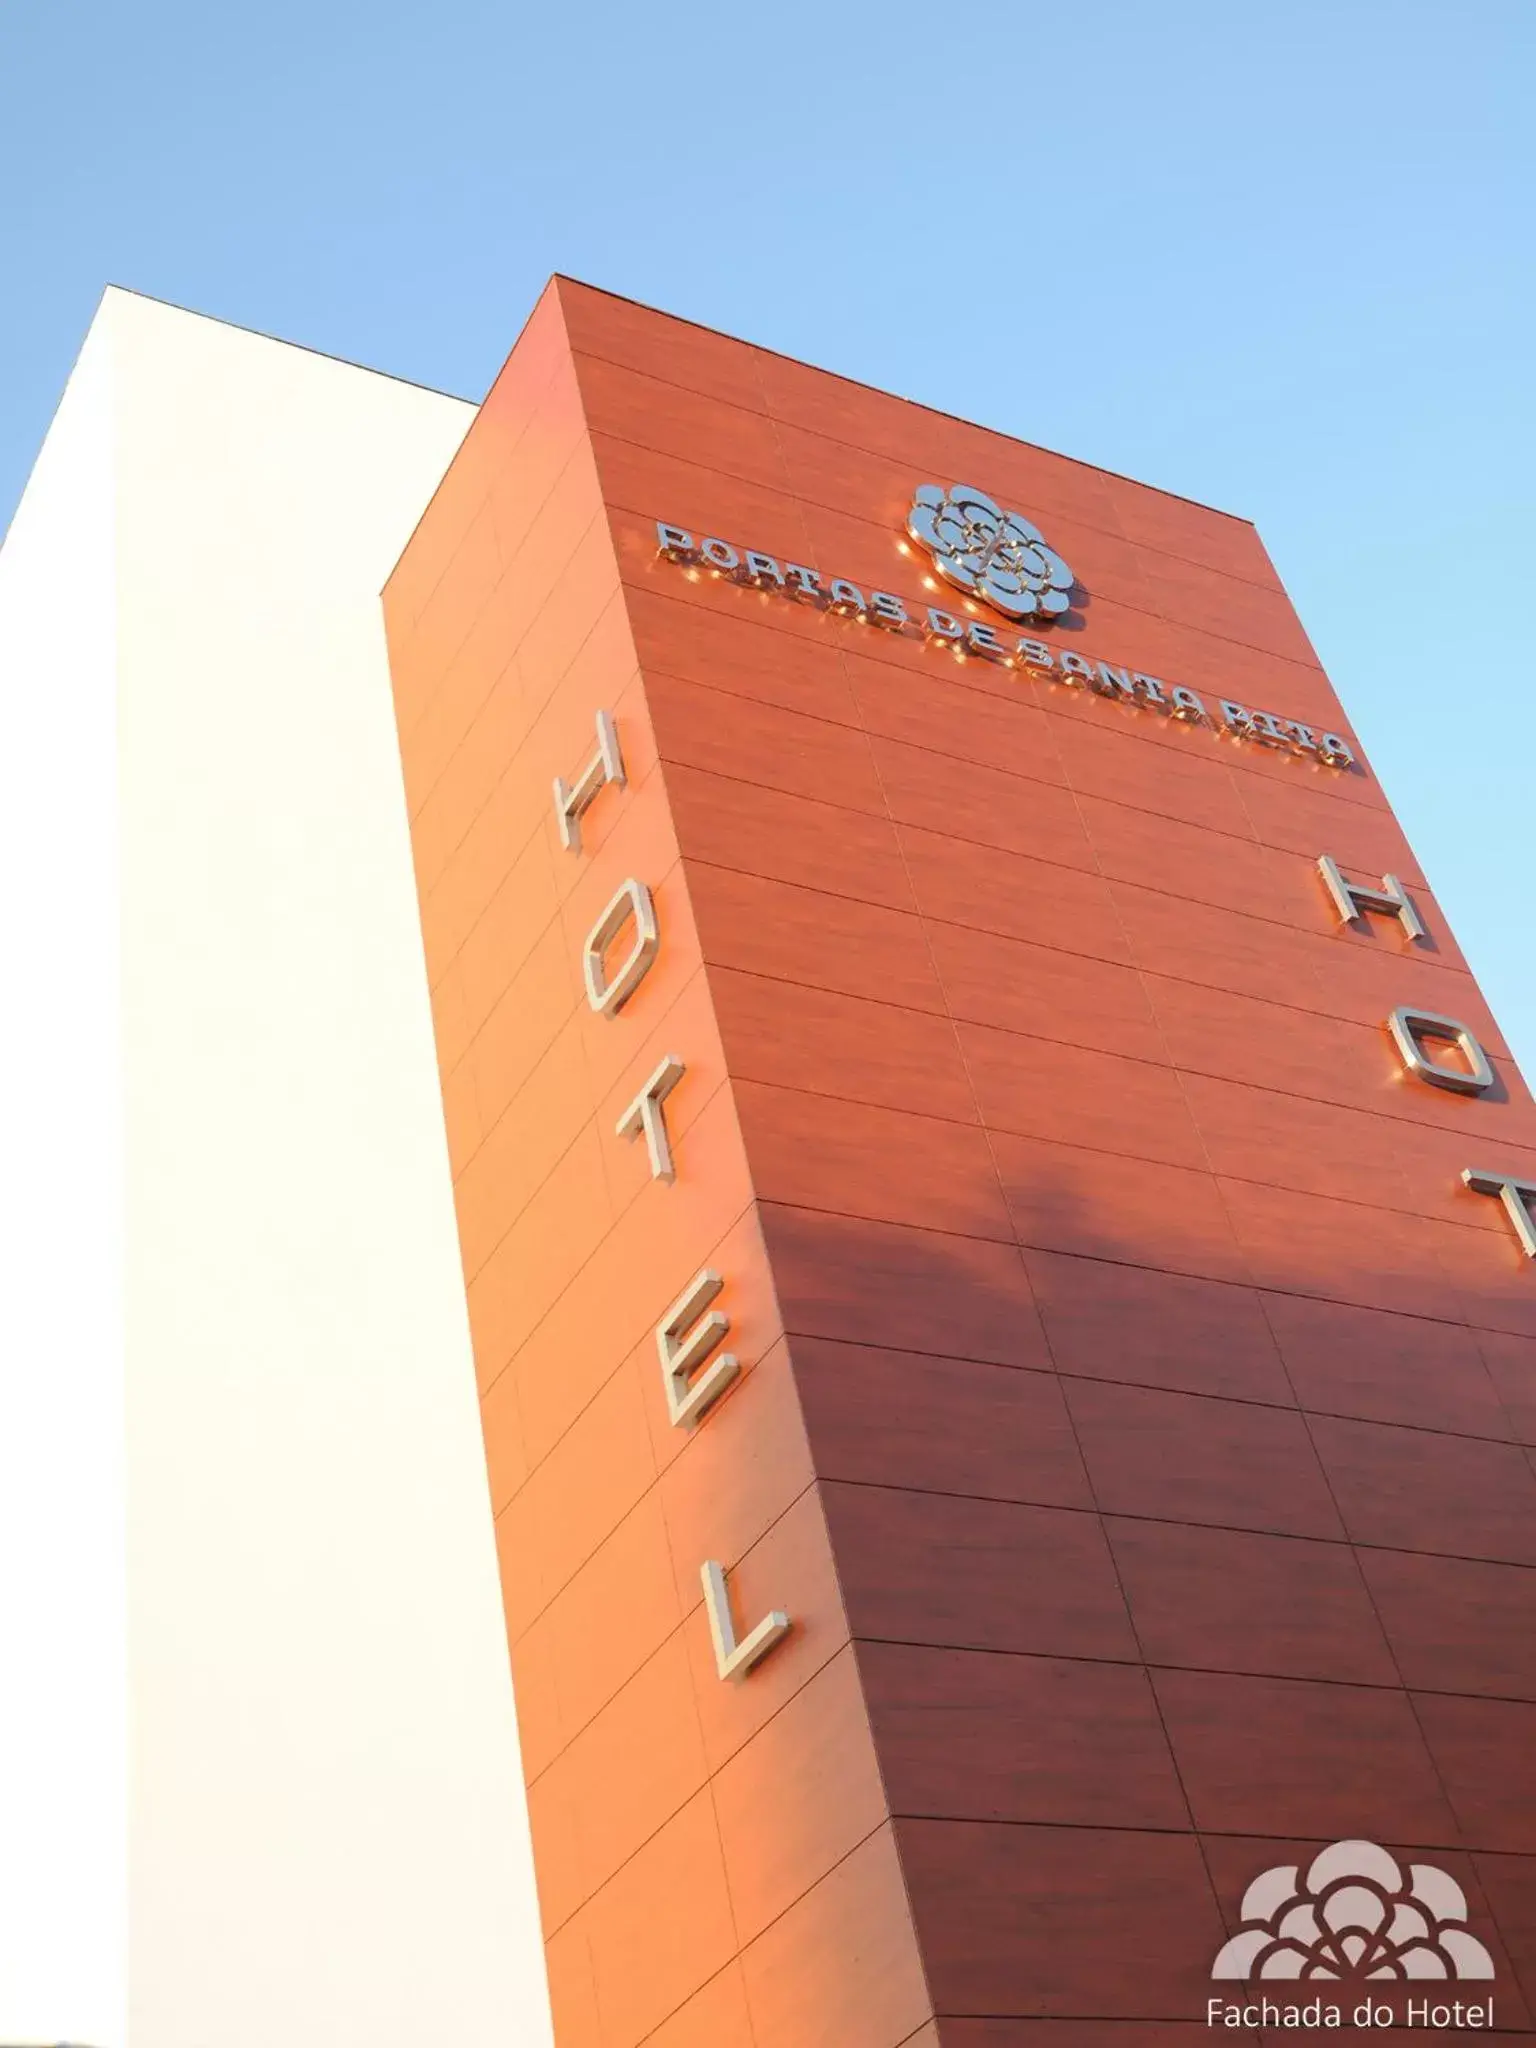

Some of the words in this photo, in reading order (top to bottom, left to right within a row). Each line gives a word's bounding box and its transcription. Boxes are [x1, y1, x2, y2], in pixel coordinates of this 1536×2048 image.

[656, 522, 908, 625] PORTAS
[926, 608, 1004, 654] DE
[1015, 638, 1207, 718] SANTA
[1219, 700, 1355, 768] RITA
[552, 710, 792, 1684] HOTEL
